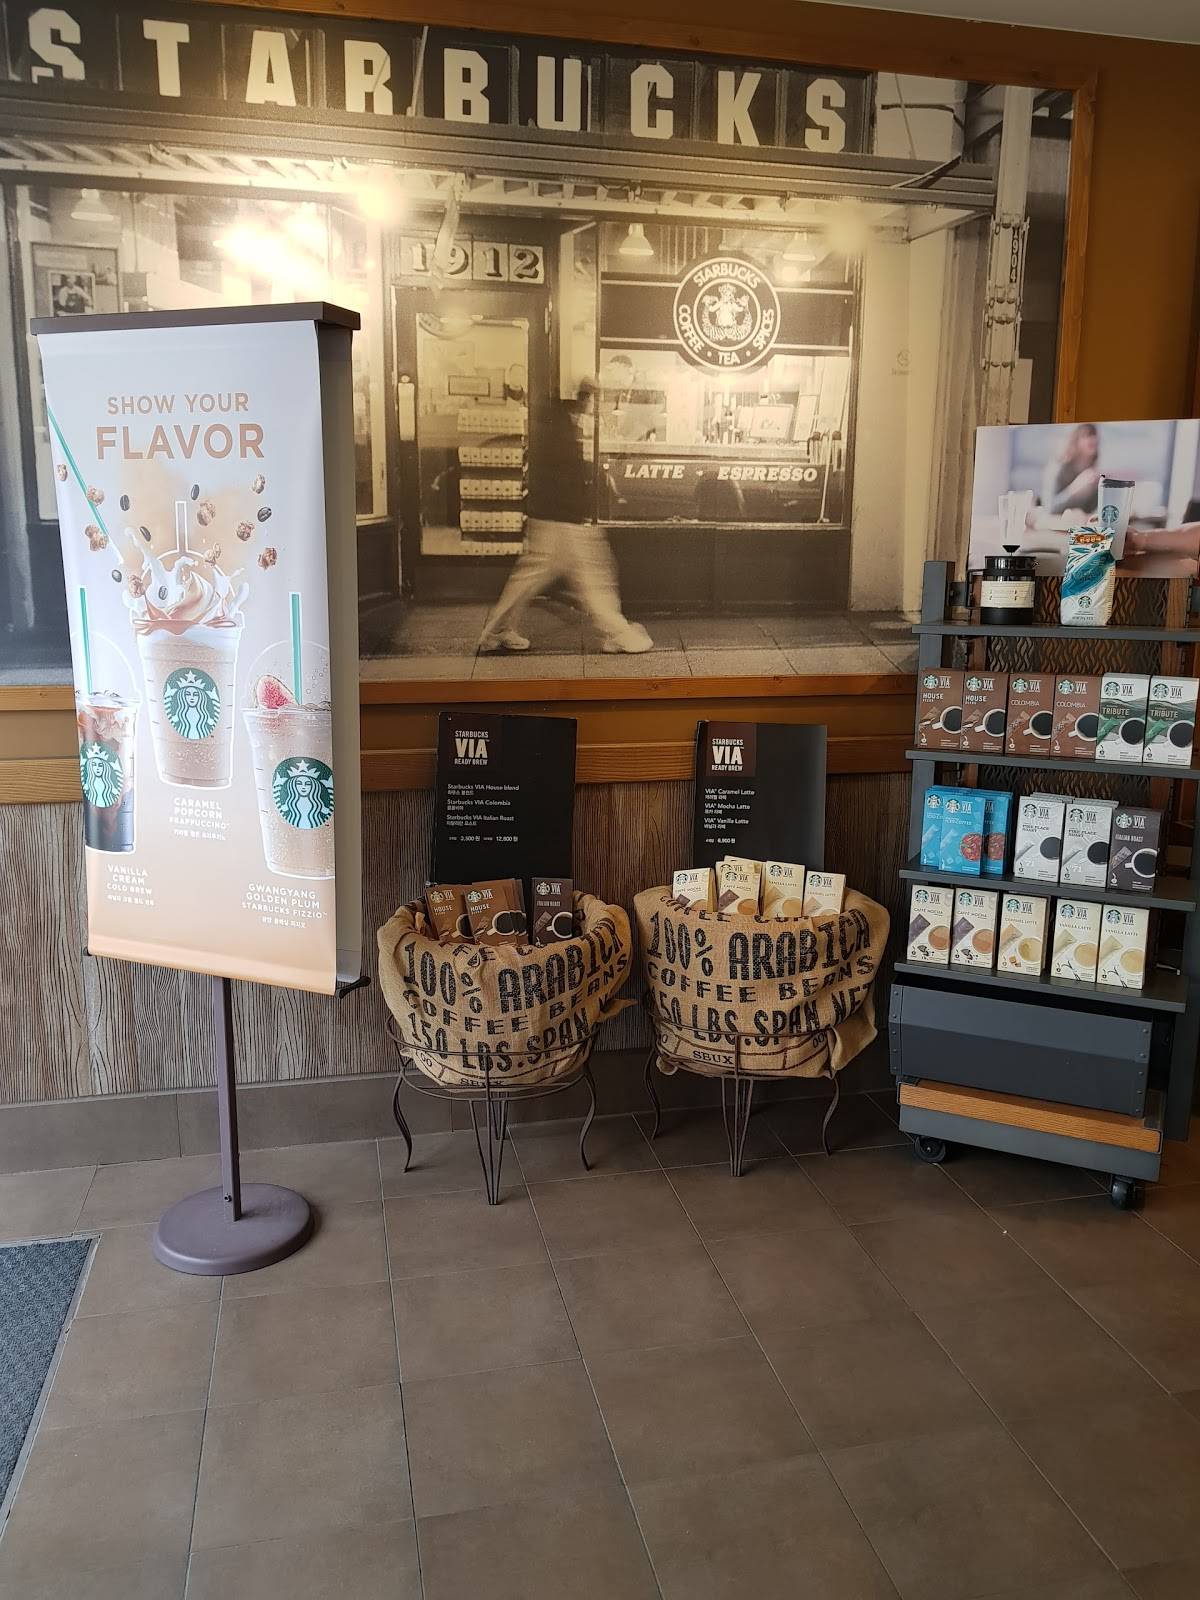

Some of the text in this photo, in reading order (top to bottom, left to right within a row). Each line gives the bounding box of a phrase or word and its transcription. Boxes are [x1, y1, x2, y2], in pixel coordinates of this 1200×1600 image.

[27, 8, 847, 154] STARBUCKS
[410, 242, 540, 279] 1912
[693, 263, 761, 289] STARBUCKS
[678, 304, 705, 353] COFFEE
[752, 308, 775, 350] SPICES
[718, 351, 741, 365] TEA
[107, 392, 250, 415] SHOW YOUR
[96, 423, 265, 460] FLAVOR
[624, 464, 818, 481] LATTE ESPRESSO
[923, 692, 944, 700] HOUSE
[1010, 699, 1040, 707] COLOMBIA
[1103, 707, 1130, 716] TRIBUTE
[1150, 709, 1179, 718] TRIBUTE
[454, 730, 489, 738] STARBUCKS
[711, 738, 744, 746] STARBUCKS
[455, 738, 489, 759] VIA
[712, 746, 744, 765] VIA
[173, 797, 222, 810] CARAMEL
[174, 806, 223, 820] POPCORN
[107, 864, 149, 877] VANILLA
[112, 873, 145, 886] CREAM
[248, 883, 316, 900] GWANGYANG
[241, 901, 290, 916] STARBUCKS
[246, 892, 320, 910] GOLDEN PLUM
[648, 910, 713, 977] 100%
[403, 941, 483, 1013] 100%
[648, 961, 756, 1004] COFFEE
[779, 955, 874, 1001] BEANS
[403, 953, 628, 1034] COFFEE BEANS
